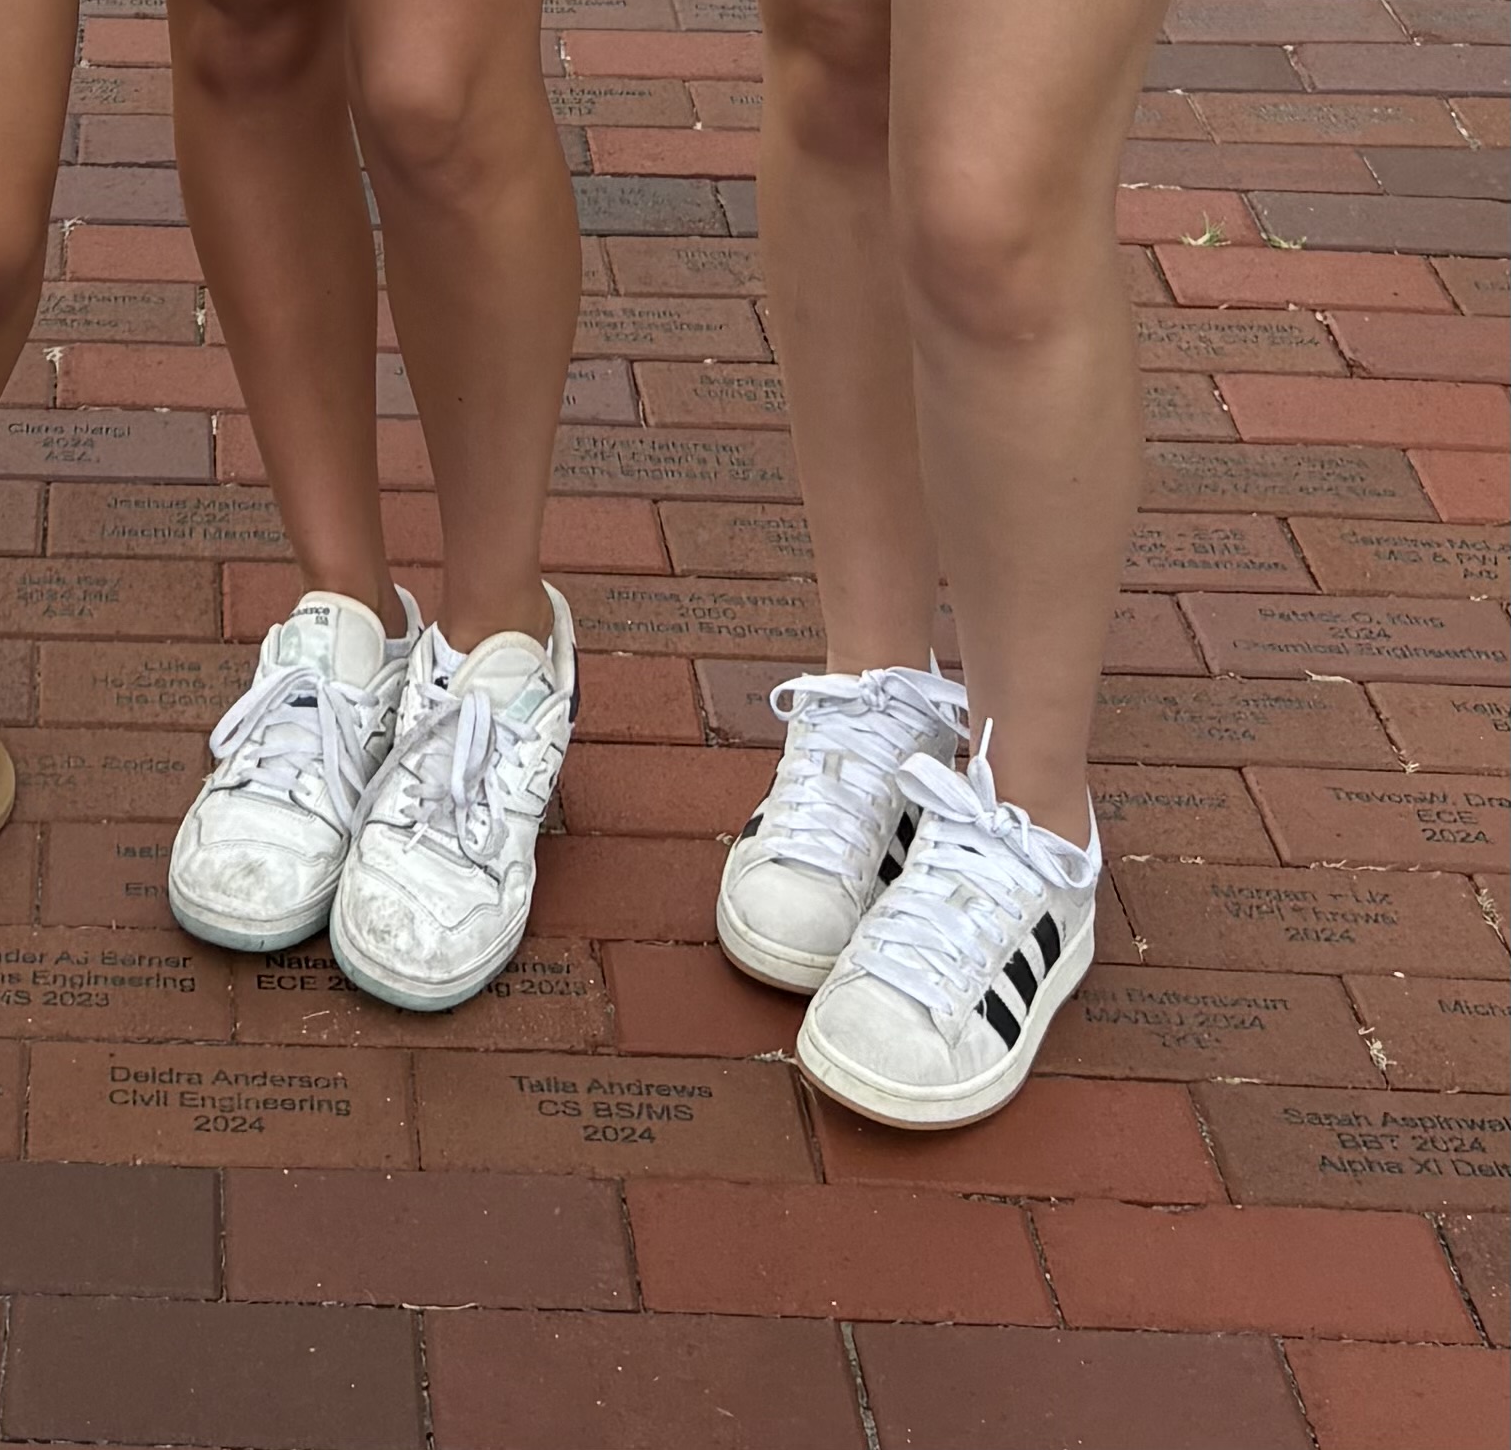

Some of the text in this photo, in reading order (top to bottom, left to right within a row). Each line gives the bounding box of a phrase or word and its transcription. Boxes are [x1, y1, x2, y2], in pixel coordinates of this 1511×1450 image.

[31, 970, 196, 993] Engineering
[256, 974, 320, 991] ECE
[108, 1065, 349, 1090] Deidra Anderson
[586, 1076, 713, 1099] Andrews
[108, 1088, 352, 1117] Civil Engineering
[537, 1098, 695, 1122] CS BS/MS
[193, 1114, 266, 1134] 2024
[1283, 1107, 1511, 1133] Sarah Aspinwal
[582, 1124, 656, 1145] 2024
[1411, 1135, 1487, 1154] 2024
[1318, 1155, 1406, 1176] Alpha
[1450, 1159, 1511, 1178] Delt
